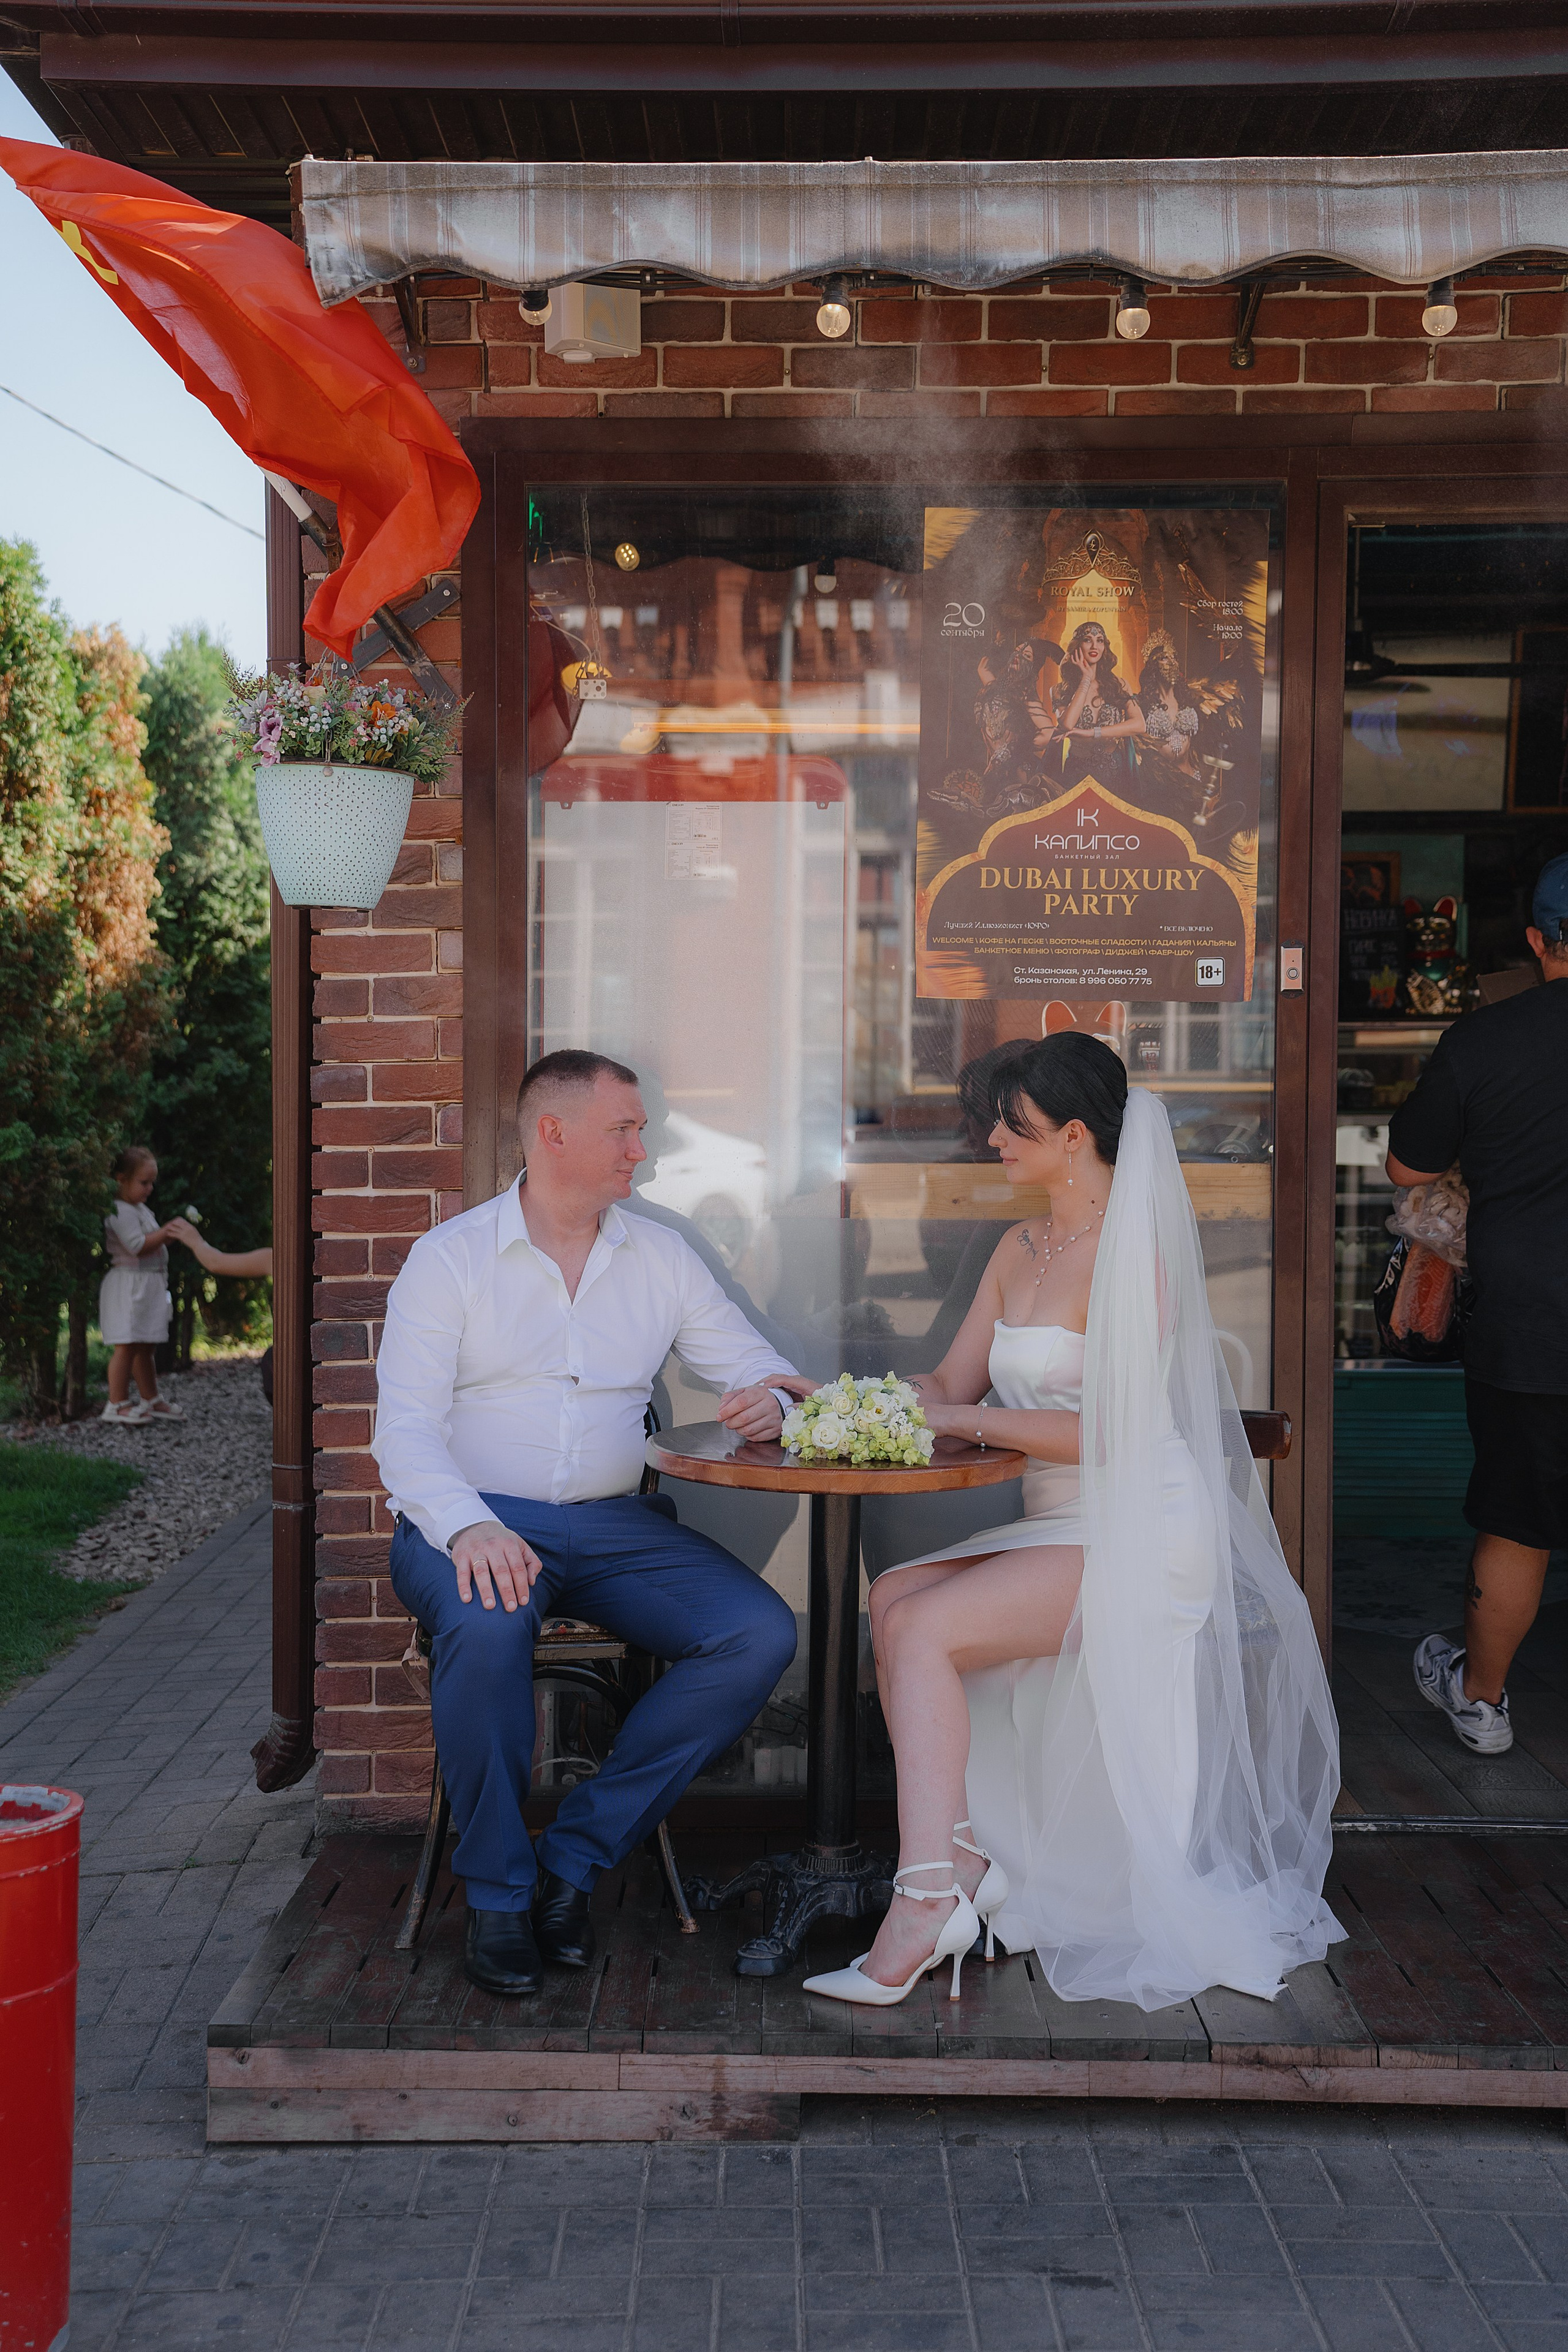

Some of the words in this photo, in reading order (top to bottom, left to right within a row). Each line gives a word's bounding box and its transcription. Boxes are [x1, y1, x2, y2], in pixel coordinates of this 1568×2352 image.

[1051, 586, 1093, 597] ROYAL
[1097, 586, 1135, 597] SHOW
[1197, 600, 1216, 609] Сбор
[943, 602, 985, 627] 20
[940, 628, 985, 638] сентября
[1035, 834, 1140, 850] КАЛИПСО
[980, 867, 1073, 889] DUBAI
[1081, 869, 1206, 891] LUXURY
[1044, 894, 1140, 916] PARTY
[1105, 948, 1144, 956] ДИДЖЕЙ
[1199, 965, 1222, 978] 18+
